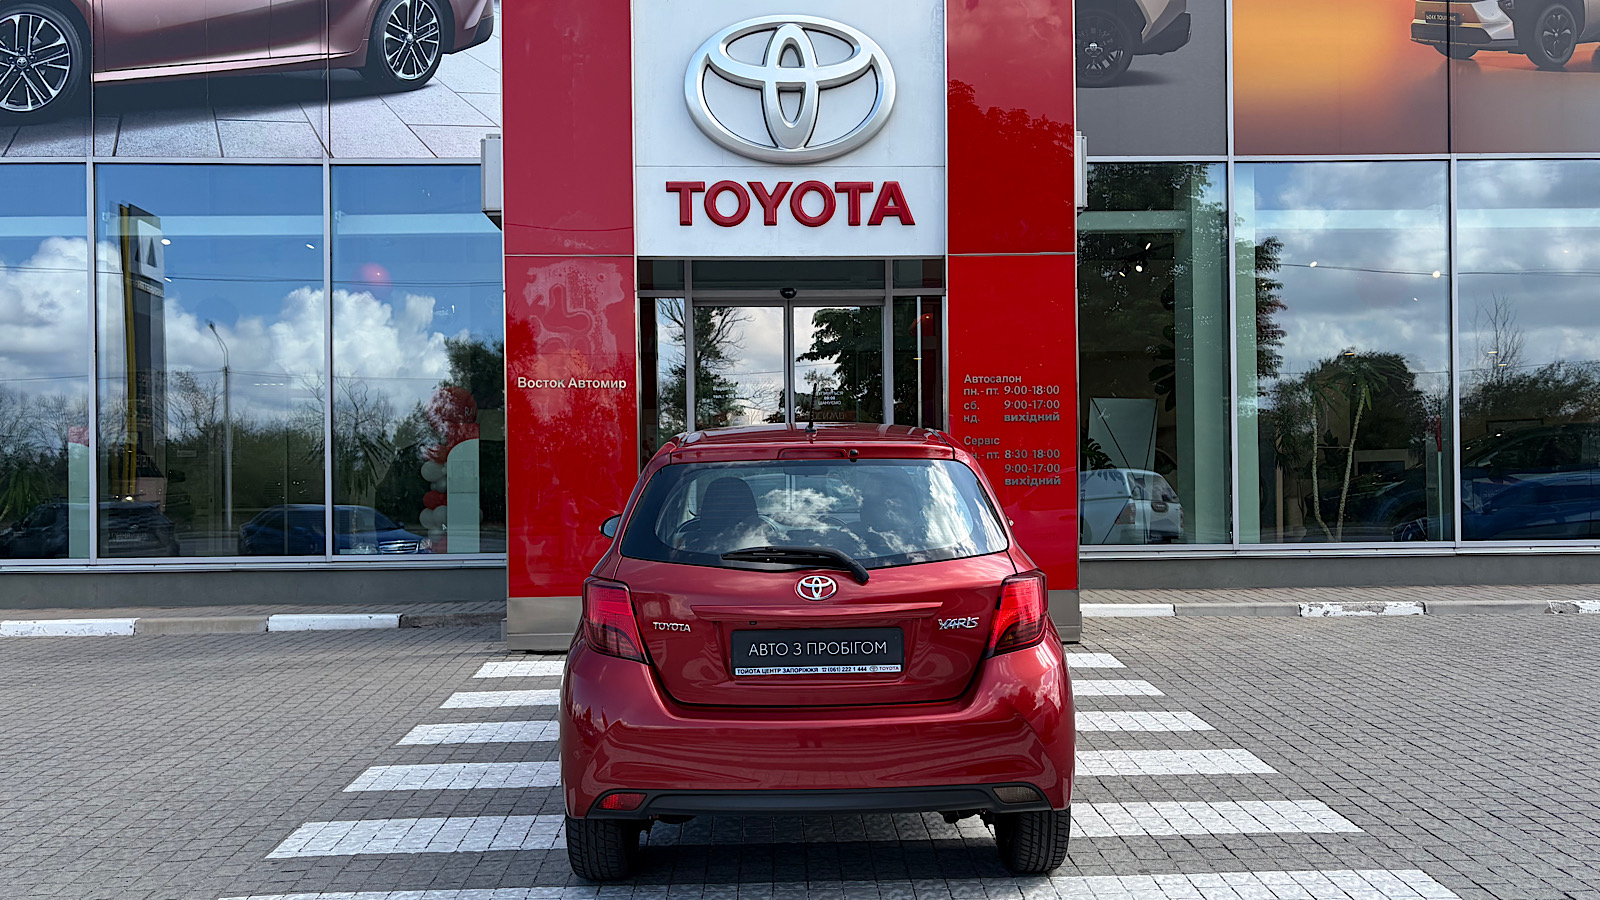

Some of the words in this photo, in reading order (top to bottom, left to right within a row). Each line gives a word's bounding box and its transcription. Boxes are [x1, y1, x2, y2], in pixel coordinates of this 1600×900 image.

[665, 180, 916, 228] TOYOTA
[517, 376, 566, 389] Восток
[568, 377, 627, 391] Автомир
[964, 374, 1021, 384] Автосалон
[1004, 385, 1060, 396] 9:00-18:00
[963, 400, 980, 410] сб.
[1004, 400, 1060, 410] 9:00-17:00
[963, 414, 981, 423] нд.
[1004, 412, 1060, 423] вихідний
[963, 435, 1000, 447] Сервіс
[1004, 463, 1061, 474] 9:00-17:00
[1004, 476, 1061, 487] вихідний
[653, 621, 691, 633] TOYOTA
[937, 616, 980, 631] YARIS
[748, 642, 789, 657] АВТО
[793, 642, 803, 656] З
[806, 640, 887, 655] ПРОБІГОМ
[736, 667, 761, 675] ТОЙОТА
[761, 667, 782, 675] ЦЕНТР
